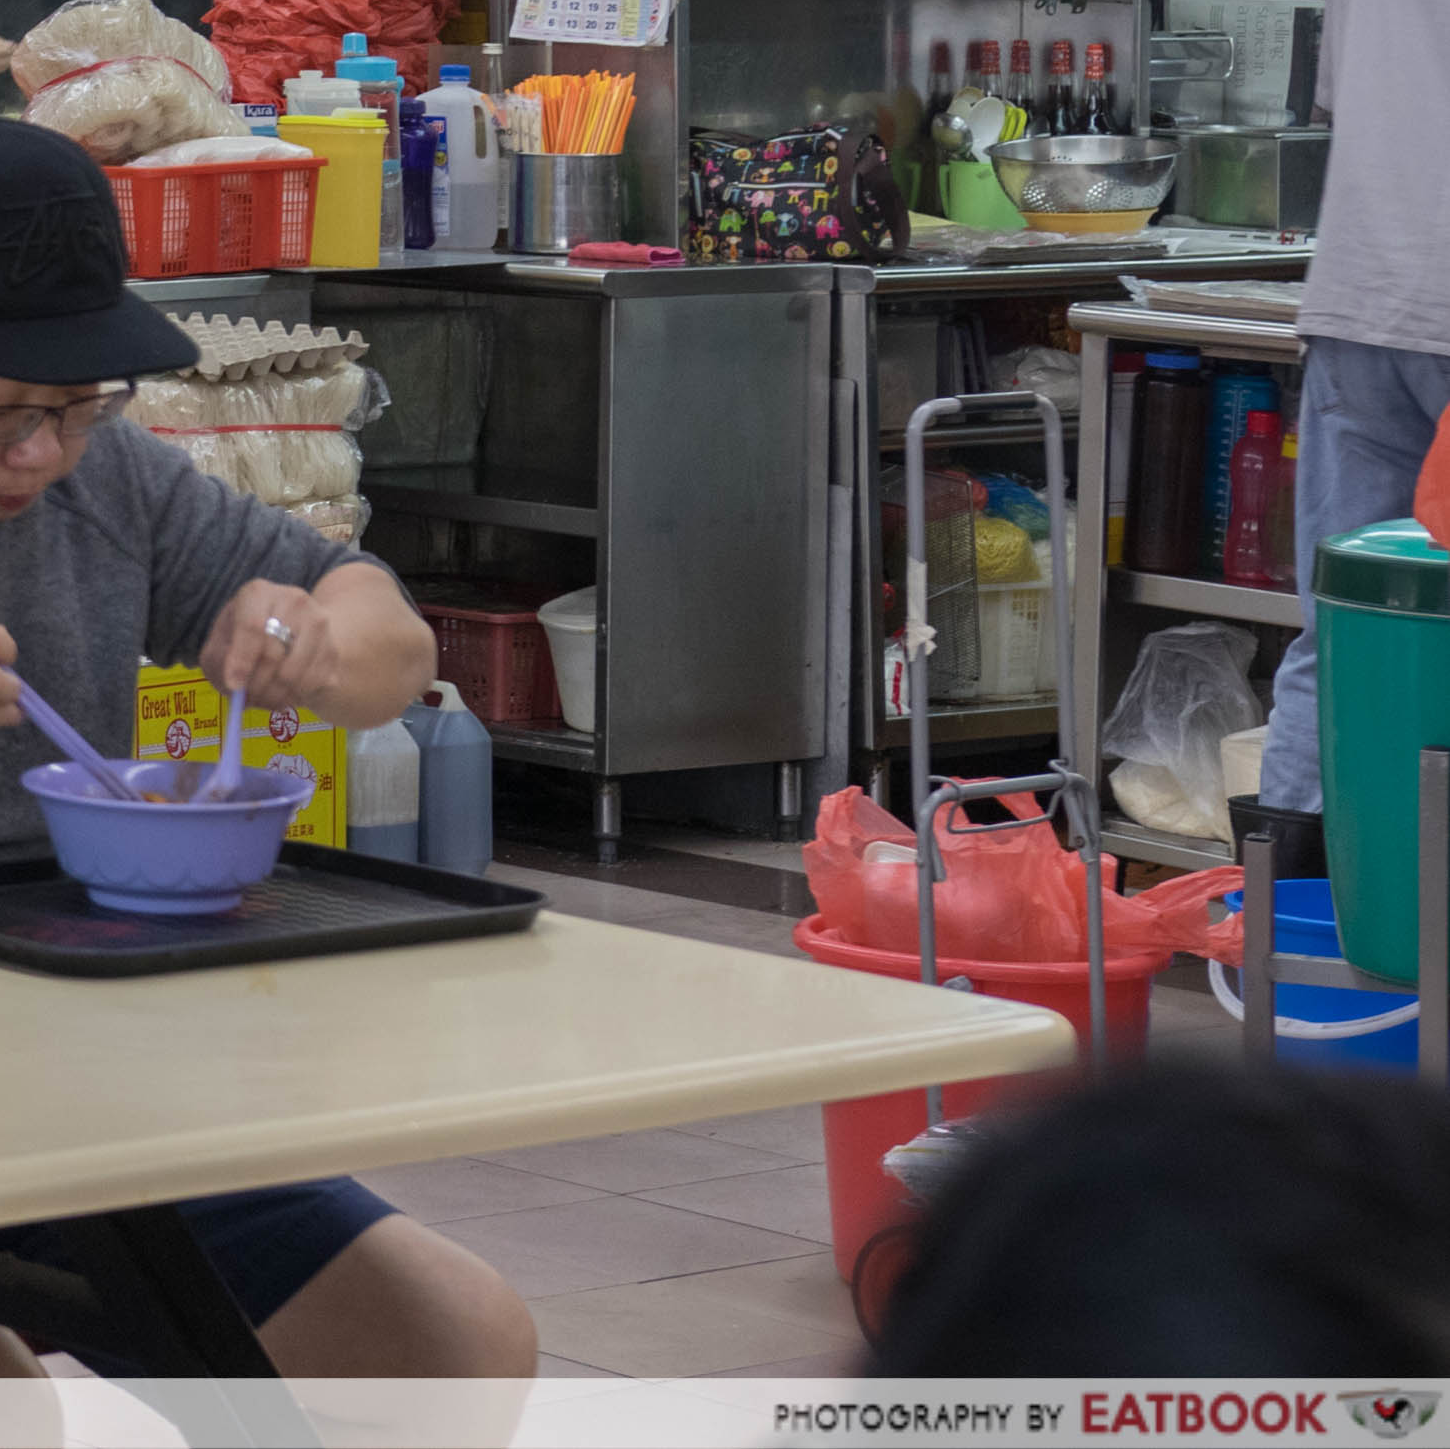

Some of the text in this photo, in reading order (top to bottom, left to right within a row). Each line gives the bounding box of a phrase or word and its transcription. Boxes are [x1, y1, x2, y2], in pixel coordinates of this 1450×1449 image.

[246, 105, 273, 117] kara
[141, 689, 196, 720] Great Wall
[194, 715, 218, 730] Brand
[319, 773, 333, 791] 油
